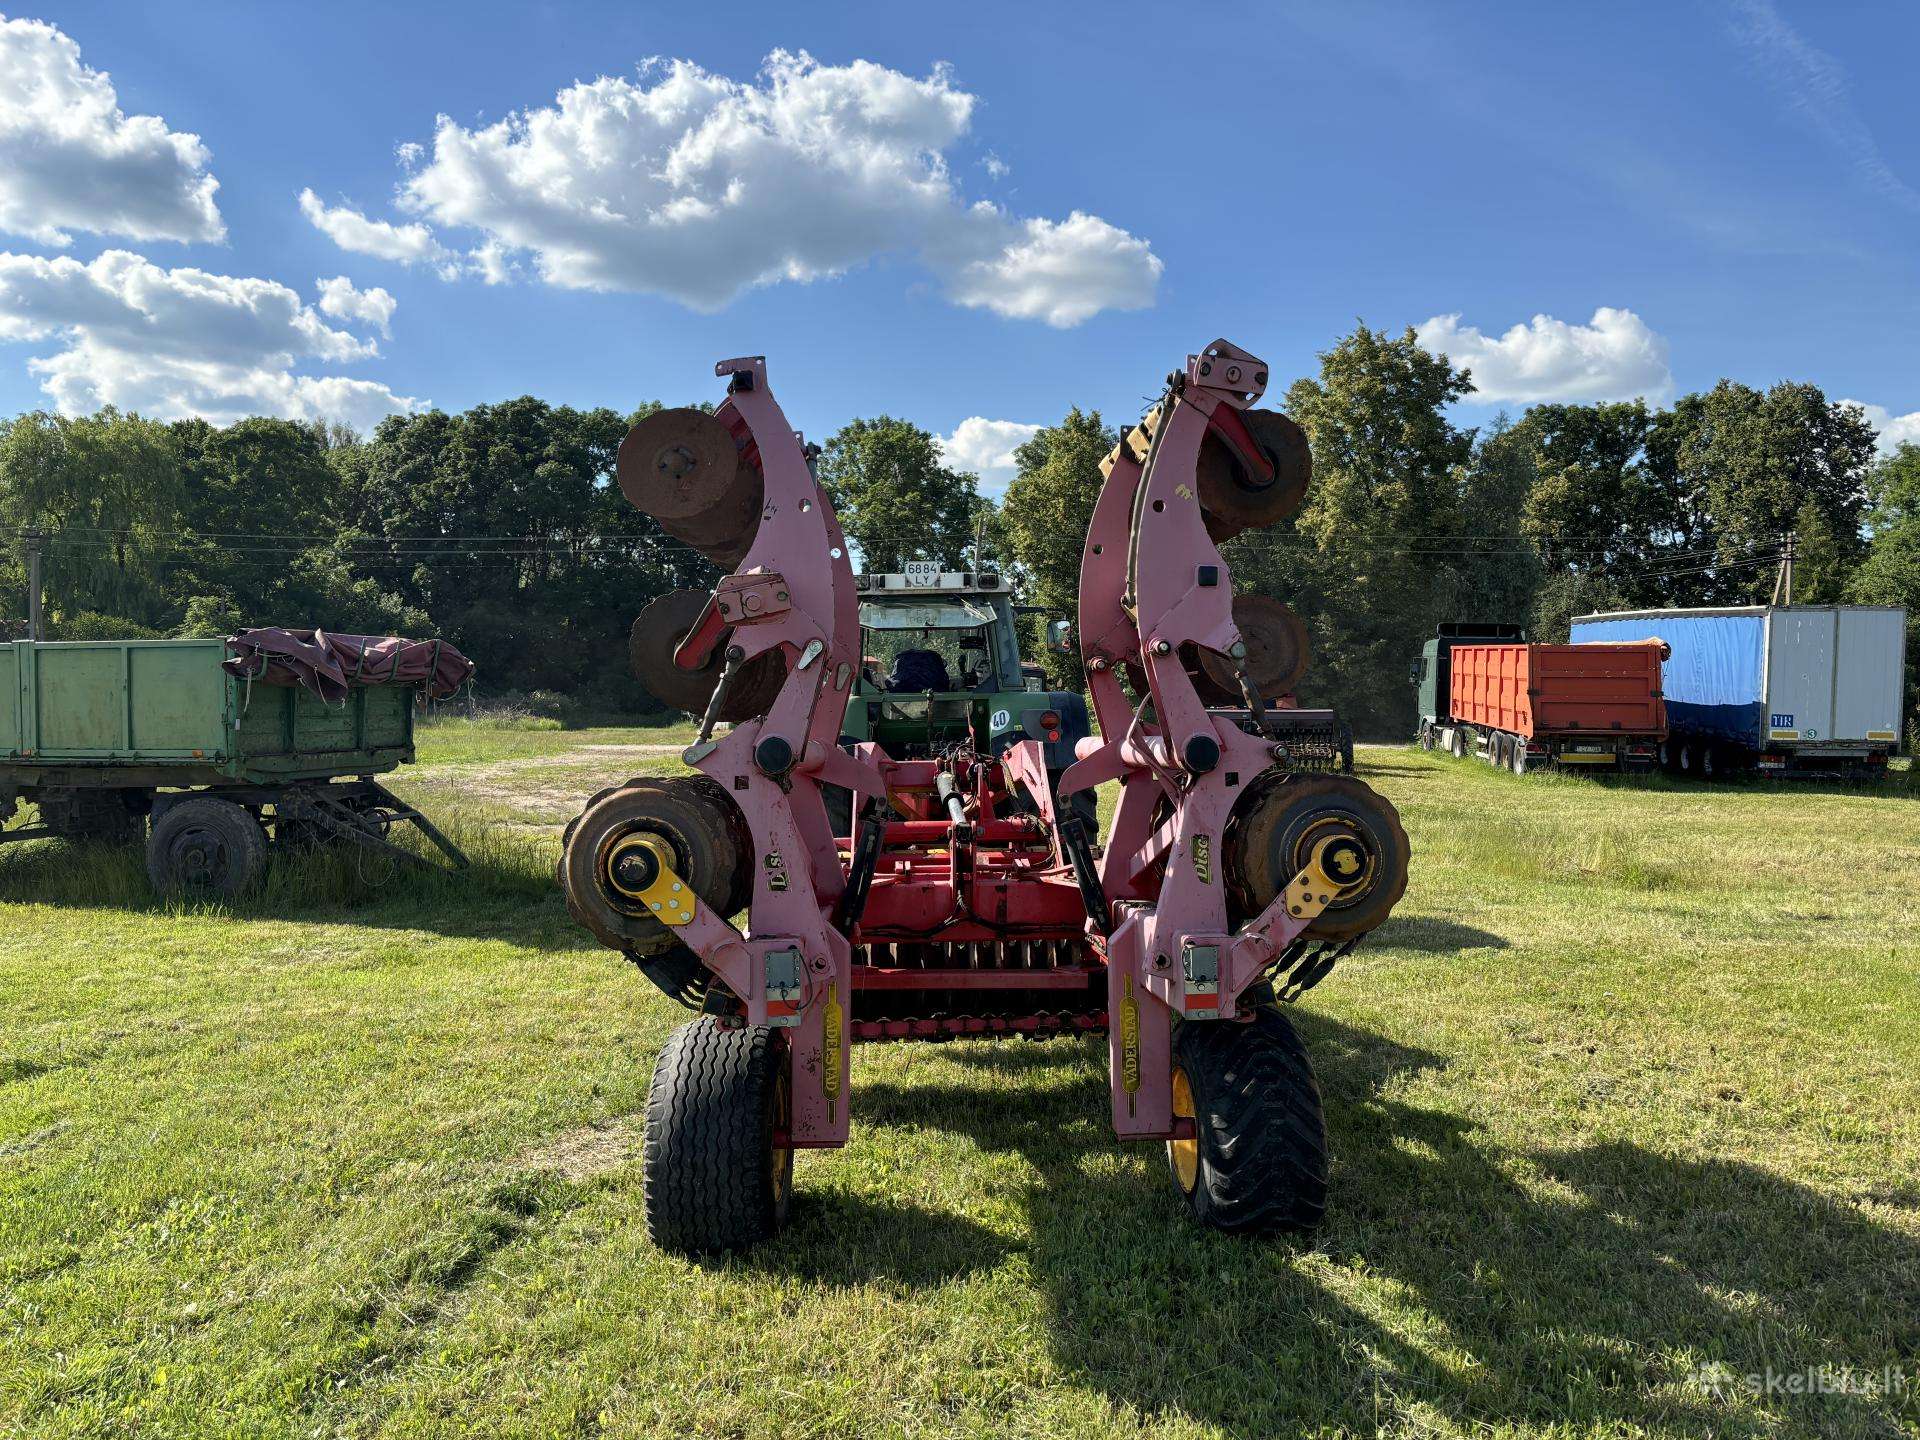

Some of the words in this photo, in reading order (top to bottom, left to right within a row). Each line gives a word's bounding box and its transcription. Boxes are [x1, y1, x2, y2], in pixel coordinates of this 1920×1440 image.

[908, 563, 937, 574] 6884
[915, 576, 930, 585] LY
[993, 711, 1006, 728] 40
[1772, 715, 1792, 727] TIR
[1194, 838, 1208, 879] Disc
[1123, 1005, 1138, 1084] VÄDERSTAD
